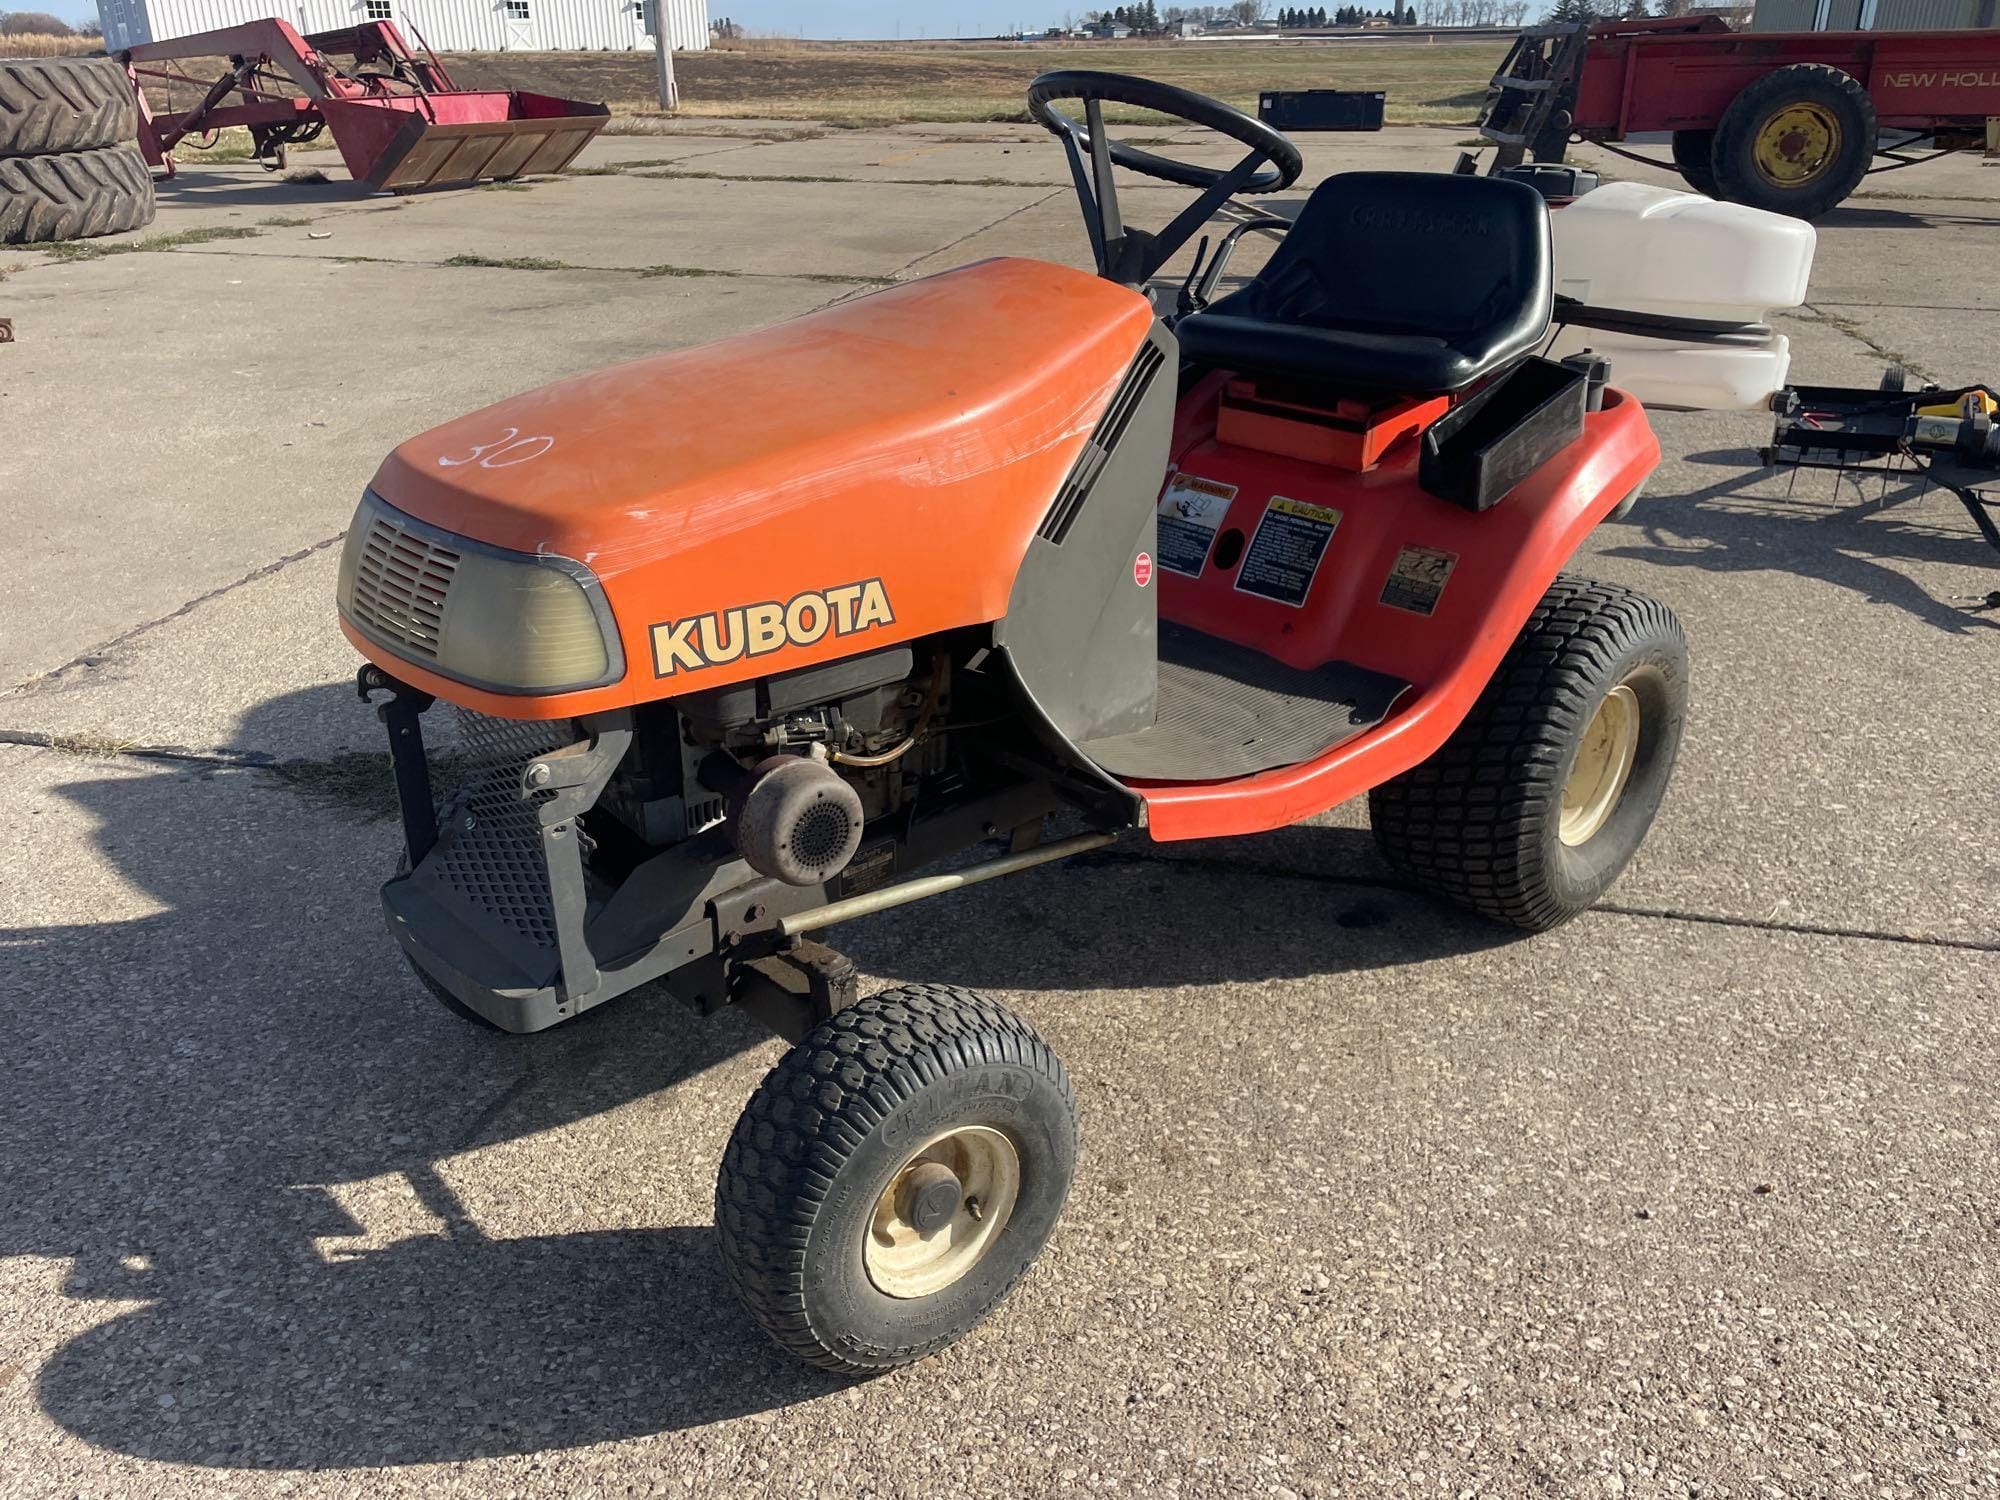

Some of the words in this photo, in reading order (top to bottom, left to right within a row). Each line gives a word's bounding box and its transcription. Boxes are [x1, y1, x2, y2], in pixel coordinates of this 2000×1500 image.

[1883, 73, 1936, 88] NEW
[438, 427, 554, 468] 30
[1190, 479, 1234, 498] WARNING
[1292, 504, 1333, 521] CAUTION
[648, 577, 896, 679] KUBOTA
